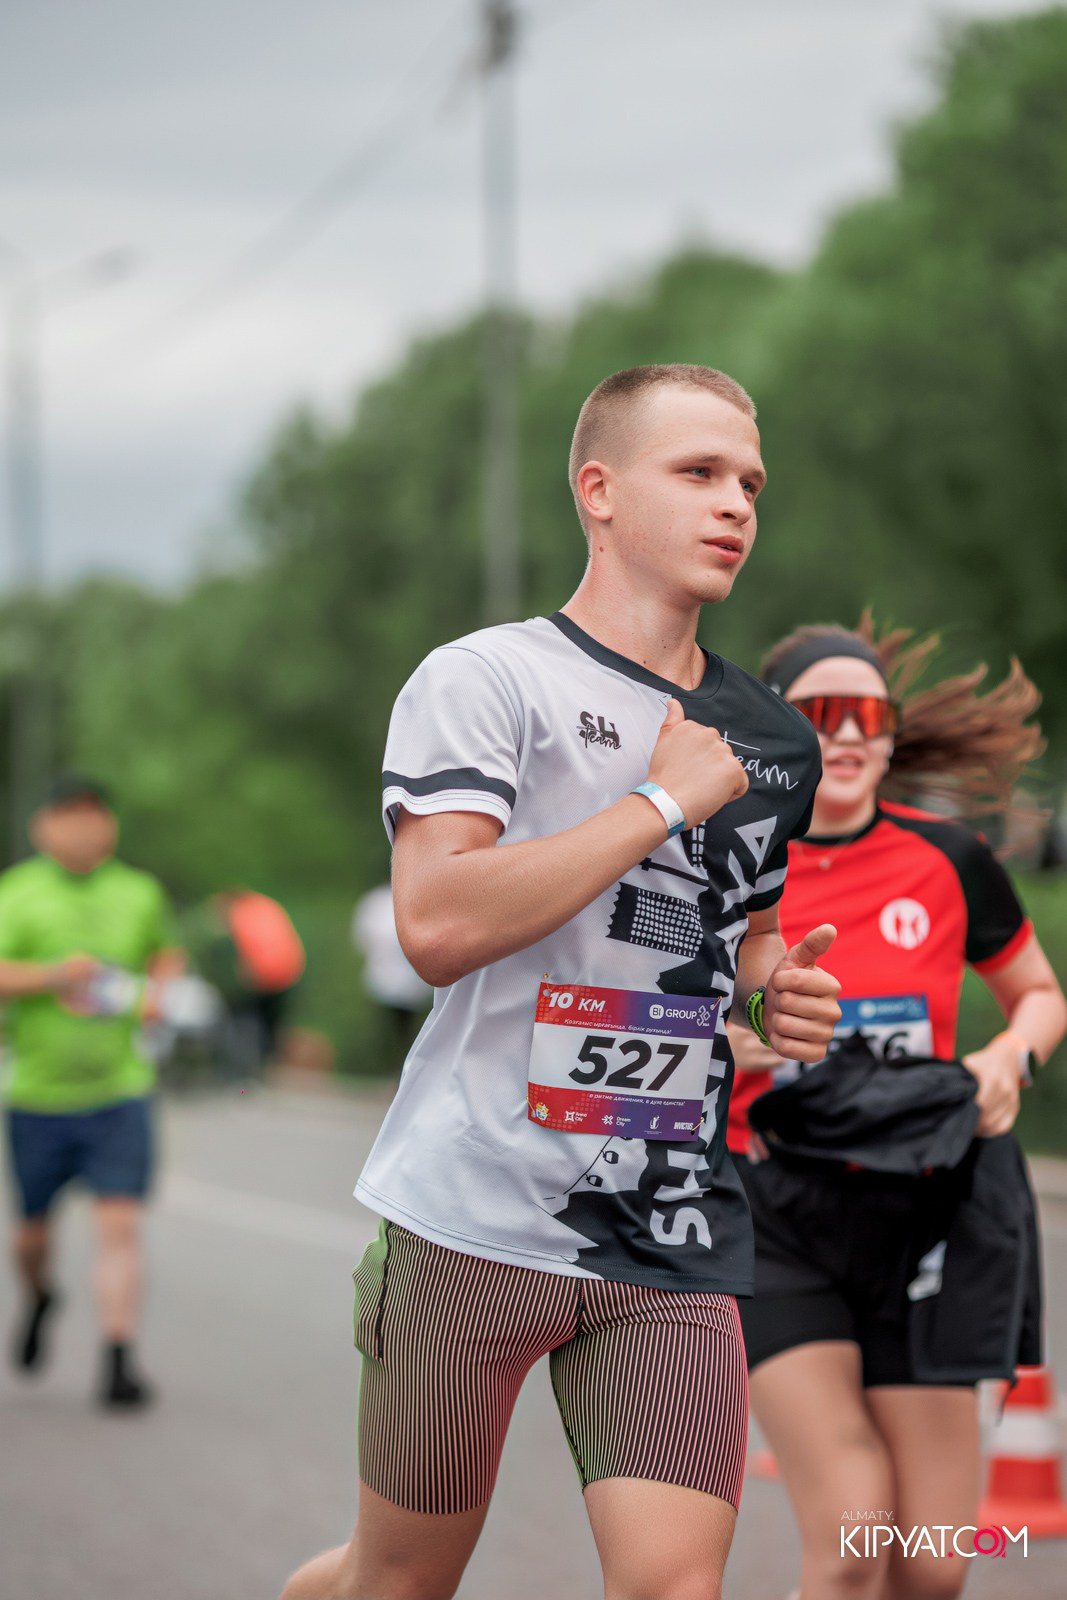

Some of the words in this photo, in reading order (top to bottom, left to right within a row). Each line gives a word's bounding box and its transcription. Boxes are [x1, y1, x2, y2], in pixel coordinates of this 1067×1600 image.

[548, 992, 574, 1009] 10
[578, 998, 606, 1013] KM
[651, 1006, 663, 1018] BI
[665, 1008, 698, 1020] GROUP
[568, 1035, 689, 1092] 527
